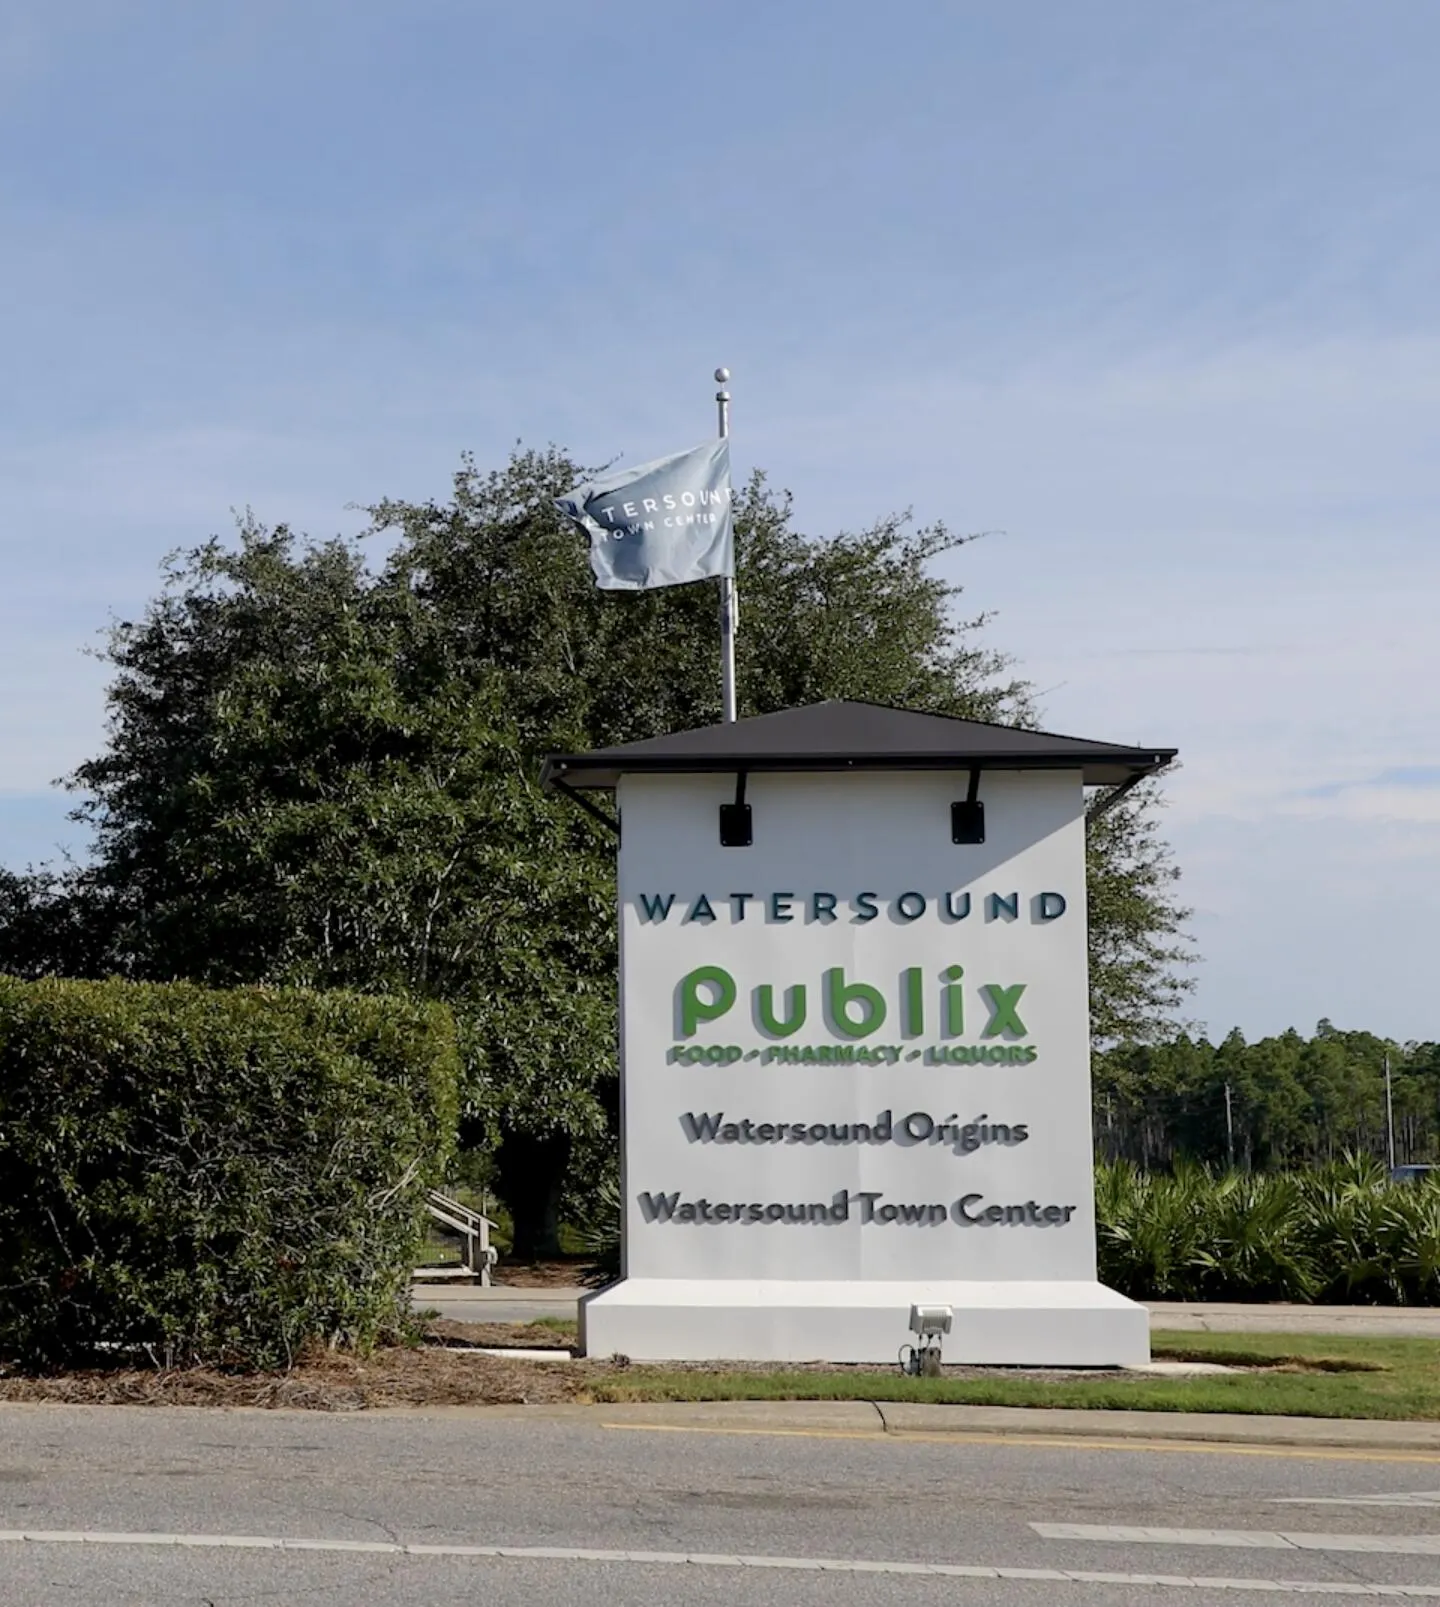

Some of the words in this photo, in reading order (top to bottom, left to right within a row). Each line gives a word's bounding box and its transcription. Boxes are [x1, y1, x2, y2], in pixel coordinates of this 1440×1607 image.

[601, 520, 655, 542] TOWN
[663, 512, 716, 528] CENTER
[639, 891, 1067, 922] WATERSOUND
[680, 964, 1027, 1037] Publix
[672, 1045, 743, 1063] FOOD
[770, 1045, 905, 1063] PHARMACY
[930, 1045, 1039, 1063] LIQUORS
[686, 1110, 892, 1142] Watersound
[904, 1111, 1030, 1153] Origins
[642, 1189, 850, 1222] Watersound
[858, 1191, 948, 1223] Town
[960, 1193, 1078, 1223] Center
